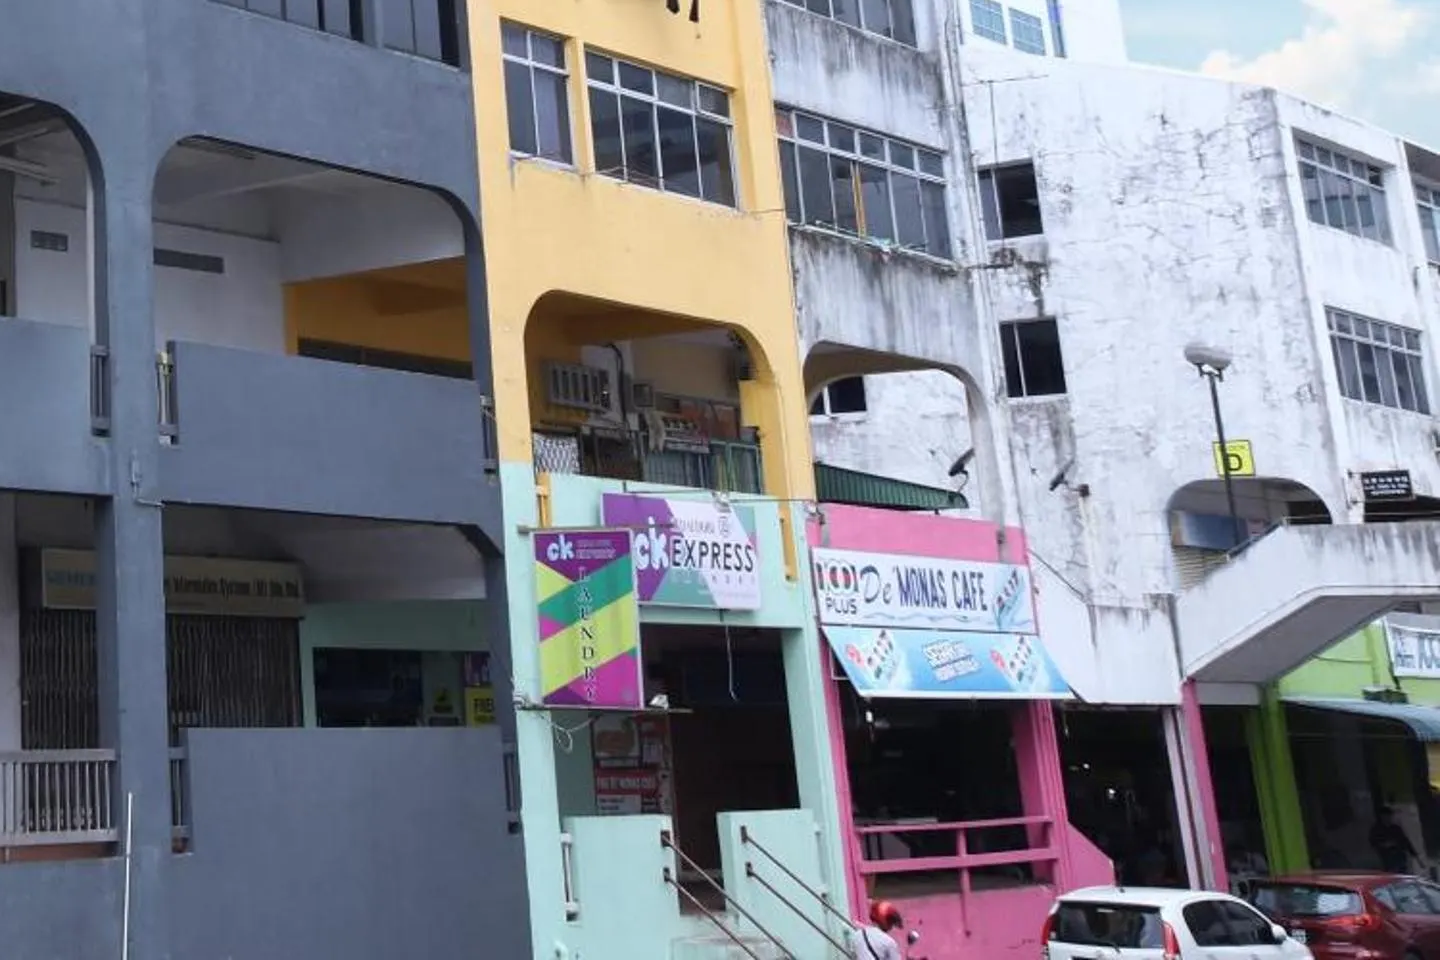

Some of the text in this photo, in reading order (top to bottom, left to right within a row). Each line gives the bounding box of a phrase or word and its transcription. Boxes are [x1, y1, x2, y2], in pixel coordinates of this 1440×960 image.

[546, 534, 575, 561] ck
[671, 538, 754, 572] EXPRESS
[825, 596, 857, 615] PLUS
[952, 570, 988, 612] CAFE
